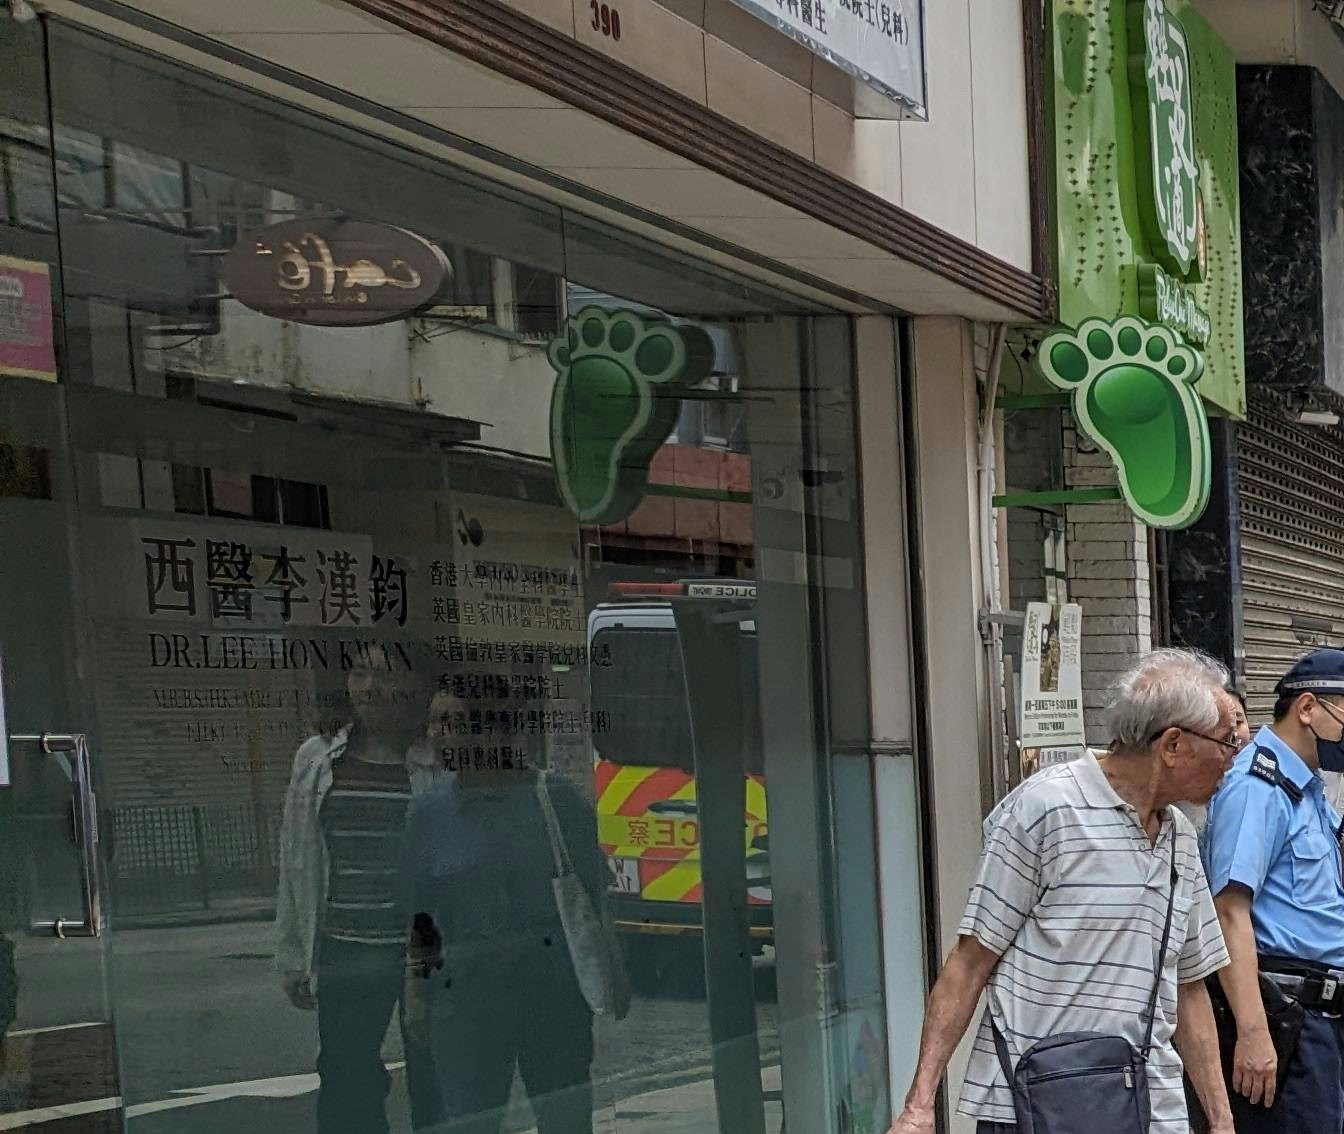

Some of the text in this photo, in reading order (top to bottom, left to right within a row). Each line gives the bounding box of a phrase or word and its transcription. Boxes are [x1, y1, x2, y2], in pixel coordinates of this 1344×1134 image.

[589, 0, 621, 42] 390
[140, 537, 409, 628] 西醫李漢鈞
[268, 638, 329, 671] HON
